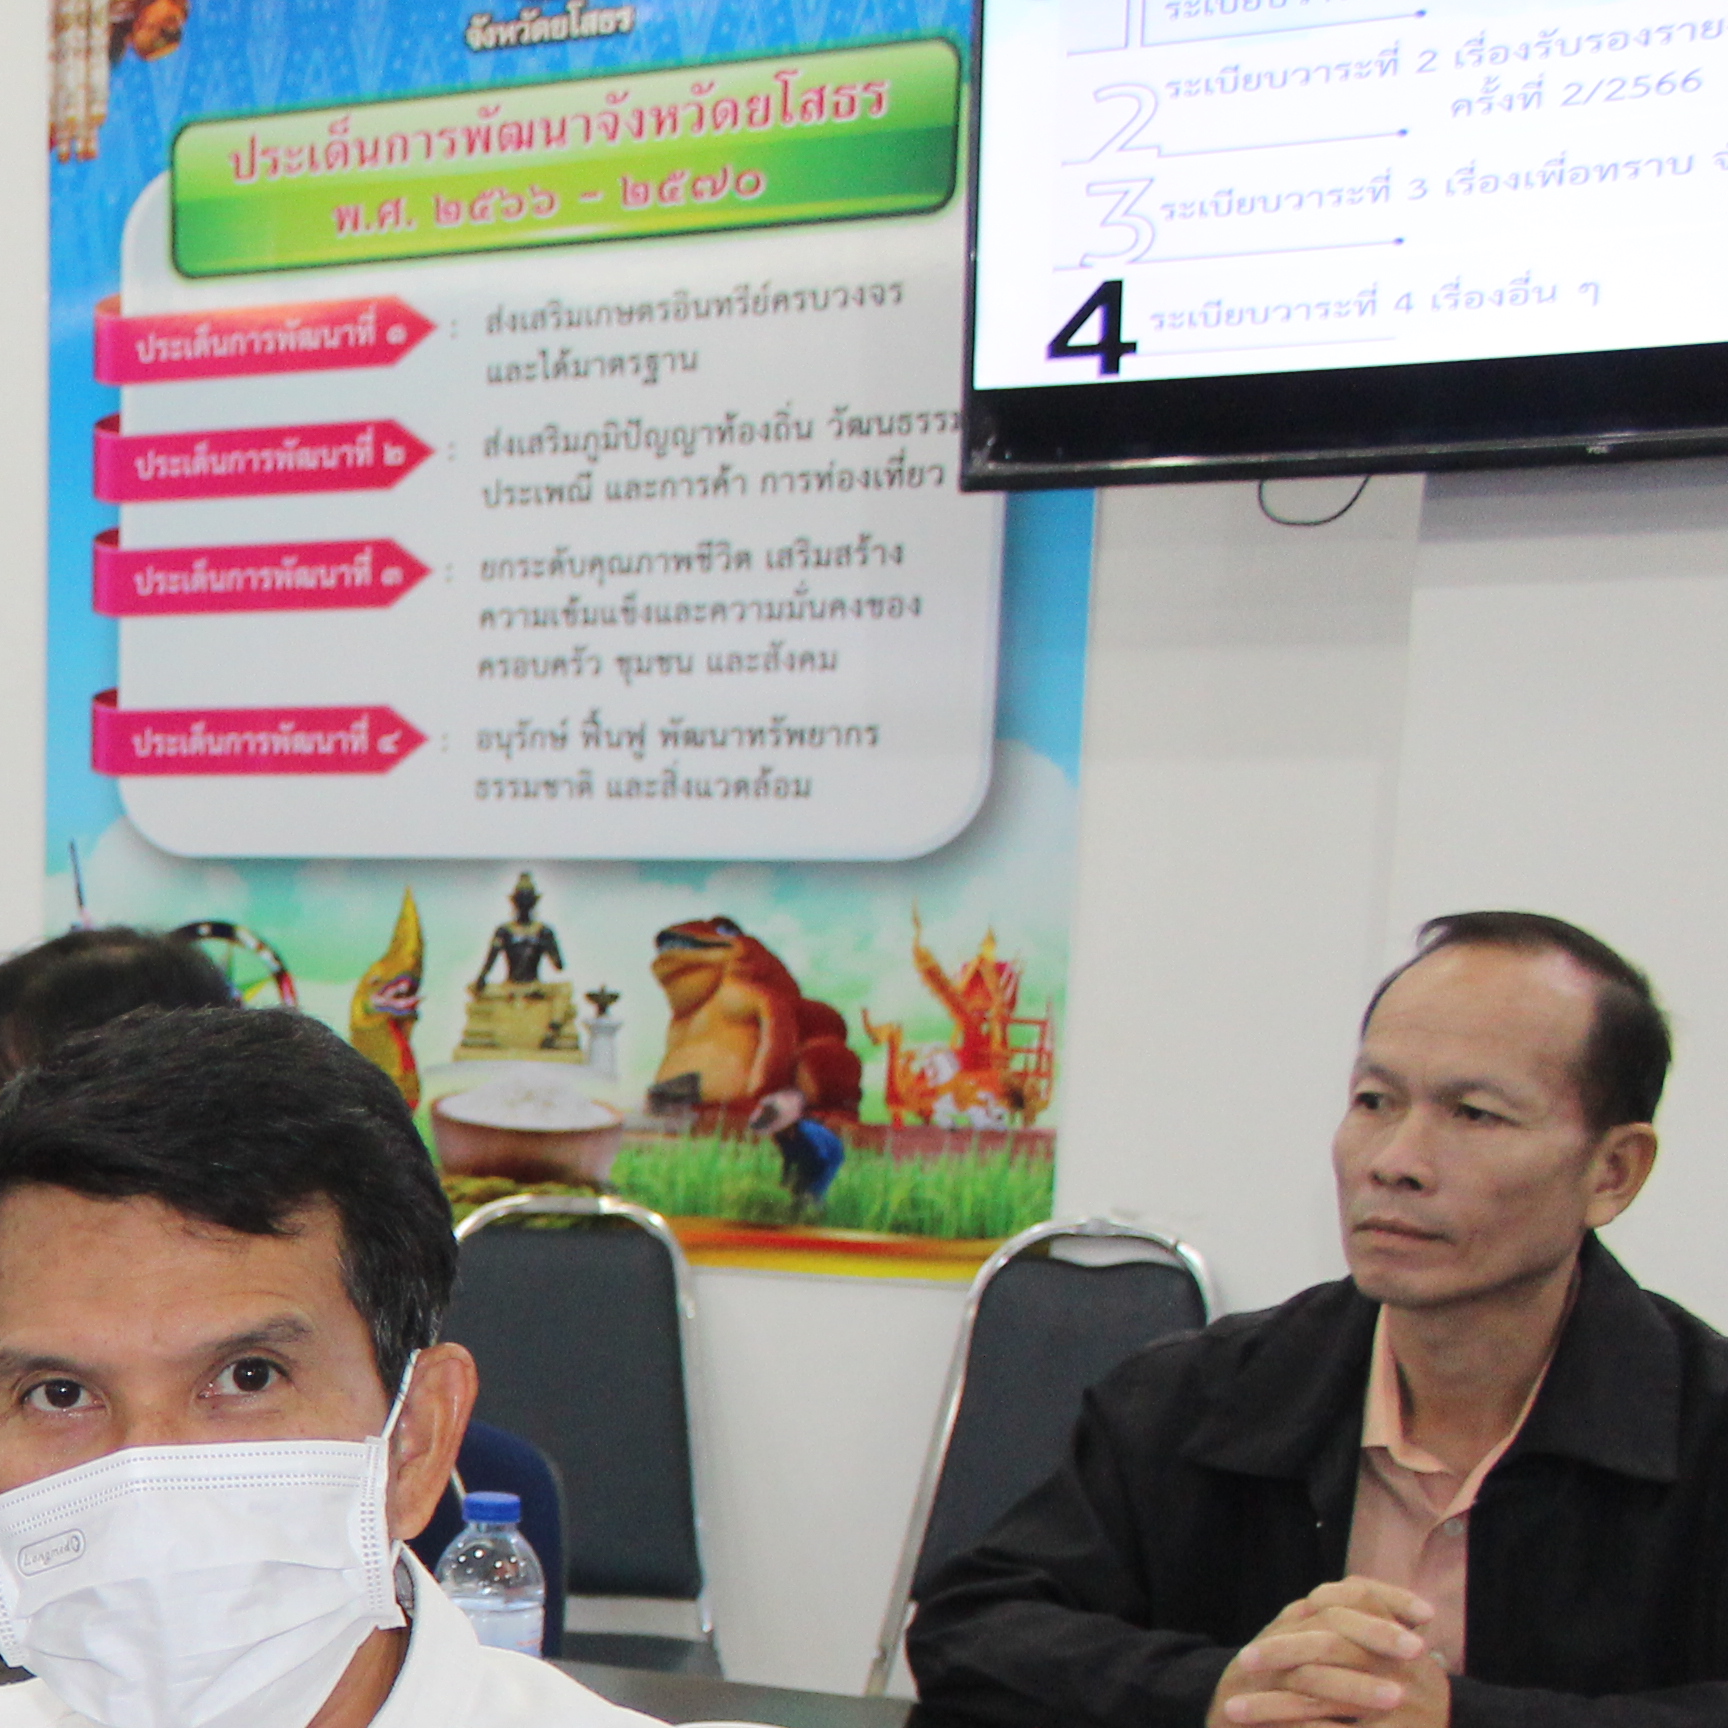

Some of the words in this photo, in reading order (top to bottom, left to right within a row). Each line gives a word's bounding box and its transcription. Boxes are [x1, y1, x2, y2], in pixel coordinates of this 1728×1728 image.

[465, 2, 635, 52] จังหวัดยโสธร
[1164, 38, 1401, 100] ระเบียบวาระที่
[1416, 48, 1438, 74] 2
[1454, 17, 1728, 70] เรื่องรับรองราย
[1450, 72, 1545, 118] ครั้งที่
[1560, 66, 1704, 108] 2/2566
[229, 68, 890, 184] ประเด็นการพัฒนาจังหวัดยโสธร
[333, 196, 417, 237] พ.ศ.
[433, 184, 559, 228] ๒๕๖๖
[619, 162, 767, 210] ๒๕๗๐
[1160, 167, 1393, 222] ระเบียบวาระที่
[1407, 178, 1429, 201] 3
[1444, 150, 1696, 199] เรื่องเพื่อทราบ
[135, 302, 378, 364] ประเด็นการพัฒนาที่
[485, 279, 904, 336] ส่งเสริมเกษตรอินทรีย์ครบวงจร
[1045, 278, 1139, 379] 4
[1149, 281, 1379, 332] ระเบียบวาระที่
[1393, 294, 1416, 315] 4
[1430, 269, 1559, 312] เรื่องอื่น
[485, 347, 700, 388] และได้มาตรฐาน
[134, 425, 376, 481] ประเด็นการพัฒนาที่
[482, 400, 814, 464] ส่งเสริมภูมิปัญญาท้องถิ่น
[481, 467, 593, 510] ประเพณี
[604, 463, 746, 502] และการค้า
[760, 447, 946, 495] การท่องเที่ยว
[133, 545, 373, 596] ประเด็นการพัฒนาที่
[479, 537, 753, 585] ยกระดับคุณภาพชีวิต
[765, 532, 905, 572] เสริมสร้าง
[478, 580, 923, 631] ความเข้มแข็งและความมั่นคงของ
[477, 645, 602, 680] ครอบครัว
[615, 652, 694, 687] ชุมชน
[706, 640, 839, 675] และสังคม
[131, 712, 370, 758] ประเด็นการพัฒนาที่
[475, 717, 570, 760] อนุรักษ์
[580, 706, 647, 761] ฟื้นฟู
[658, 715, 881, 751] พัฒนาทรัพยากร
[473, 767, 596, 801] ธรรมชาติ
[605, 759, 812, 801] และสิ่งแวดล้อม
